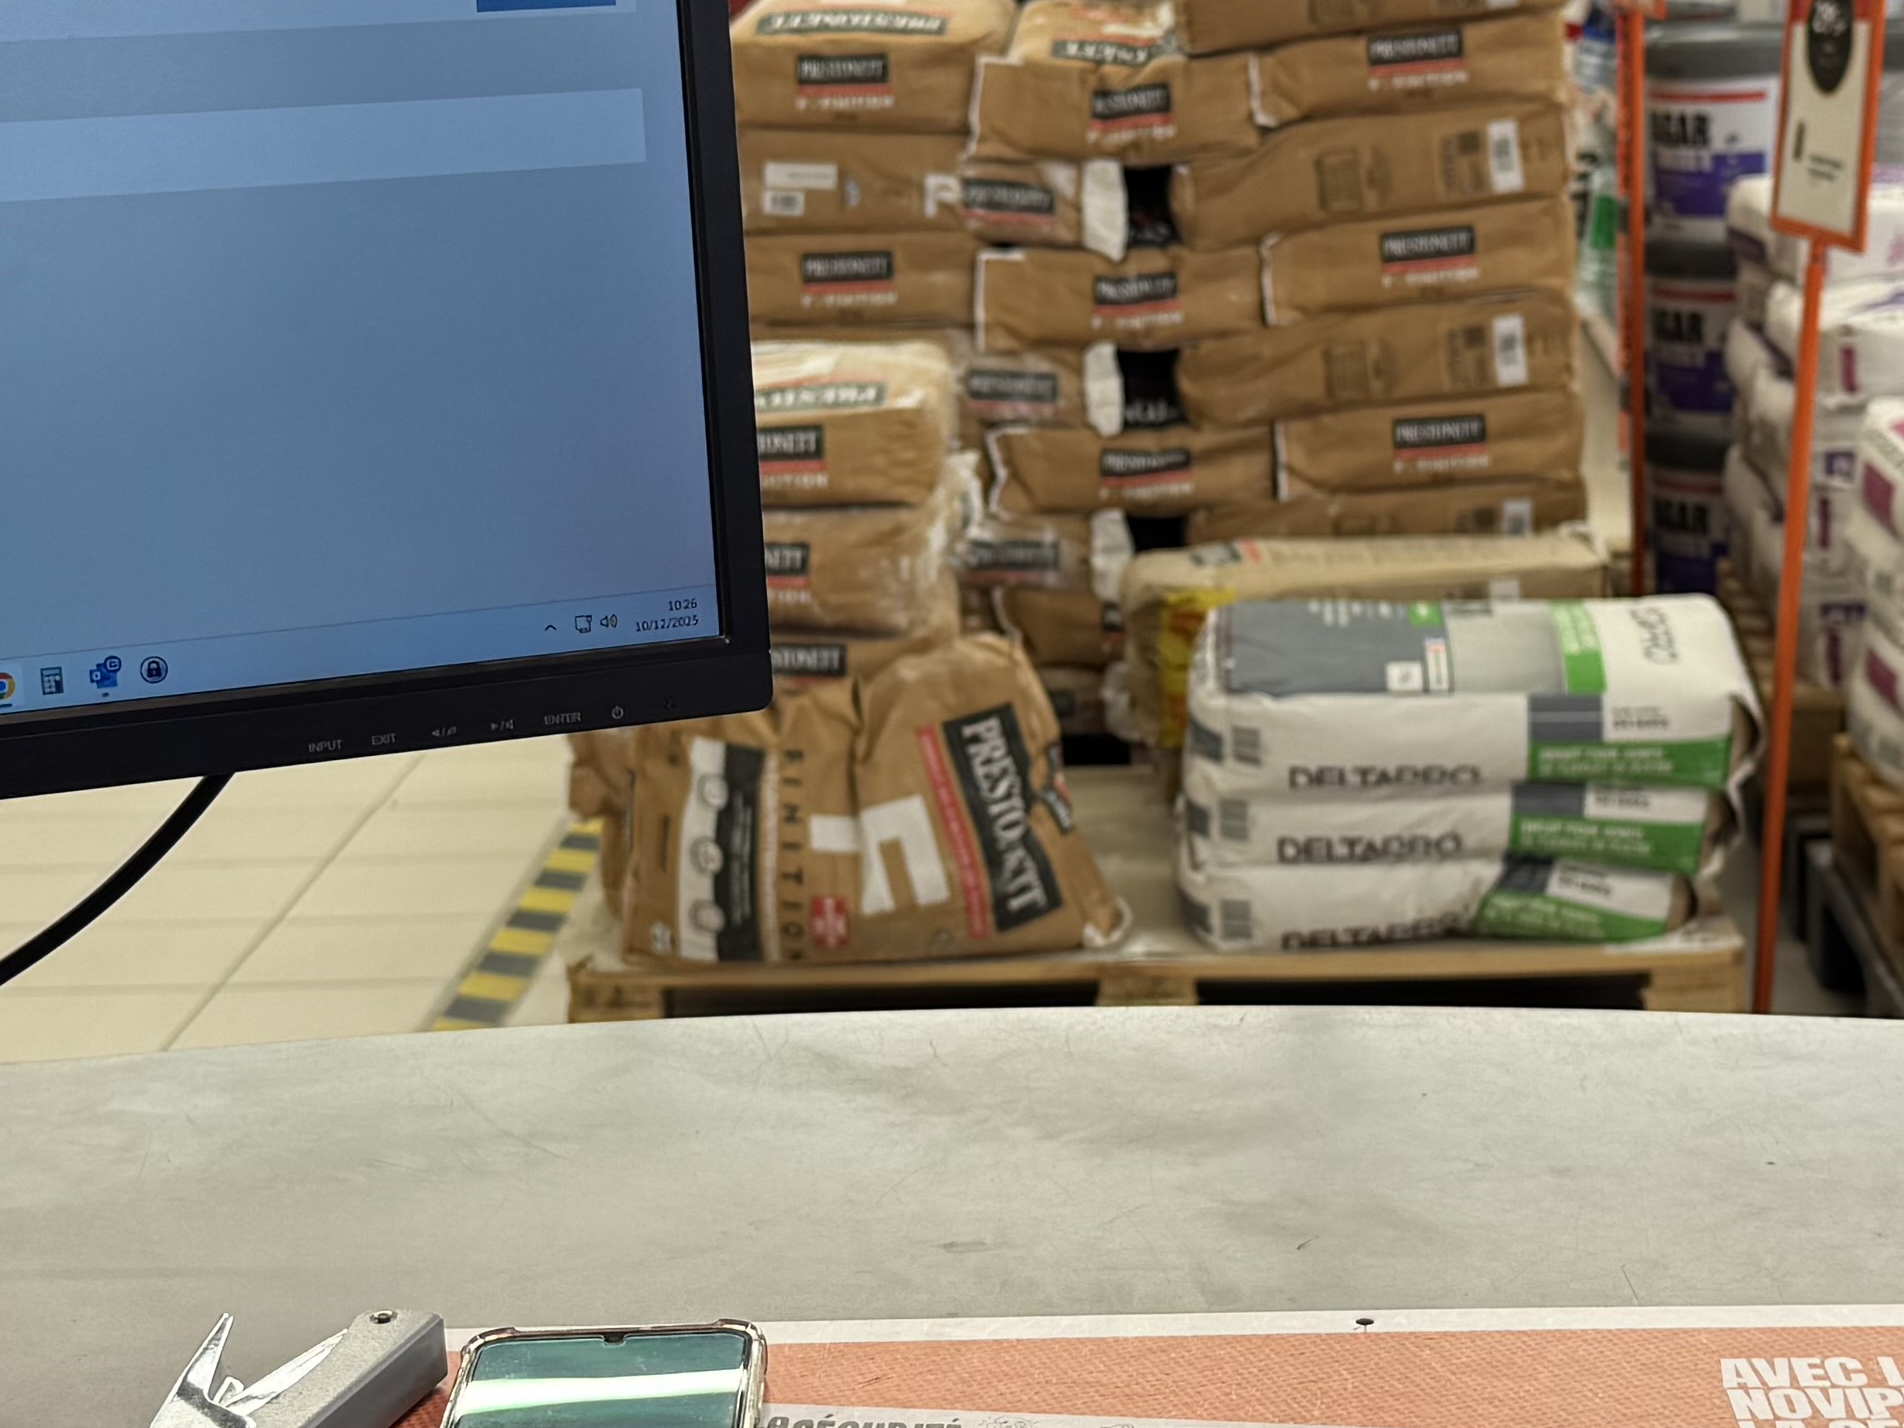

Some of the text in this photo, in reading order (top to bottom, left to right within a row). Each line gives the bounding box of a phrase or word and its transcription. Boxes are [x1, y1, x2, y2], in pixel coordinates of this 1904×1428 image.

[636, 615, 698, 632] 10/12/2025
[308, 739, 343, 753] INPUT
[1720, 1356, 1869, 1389] AVEC
